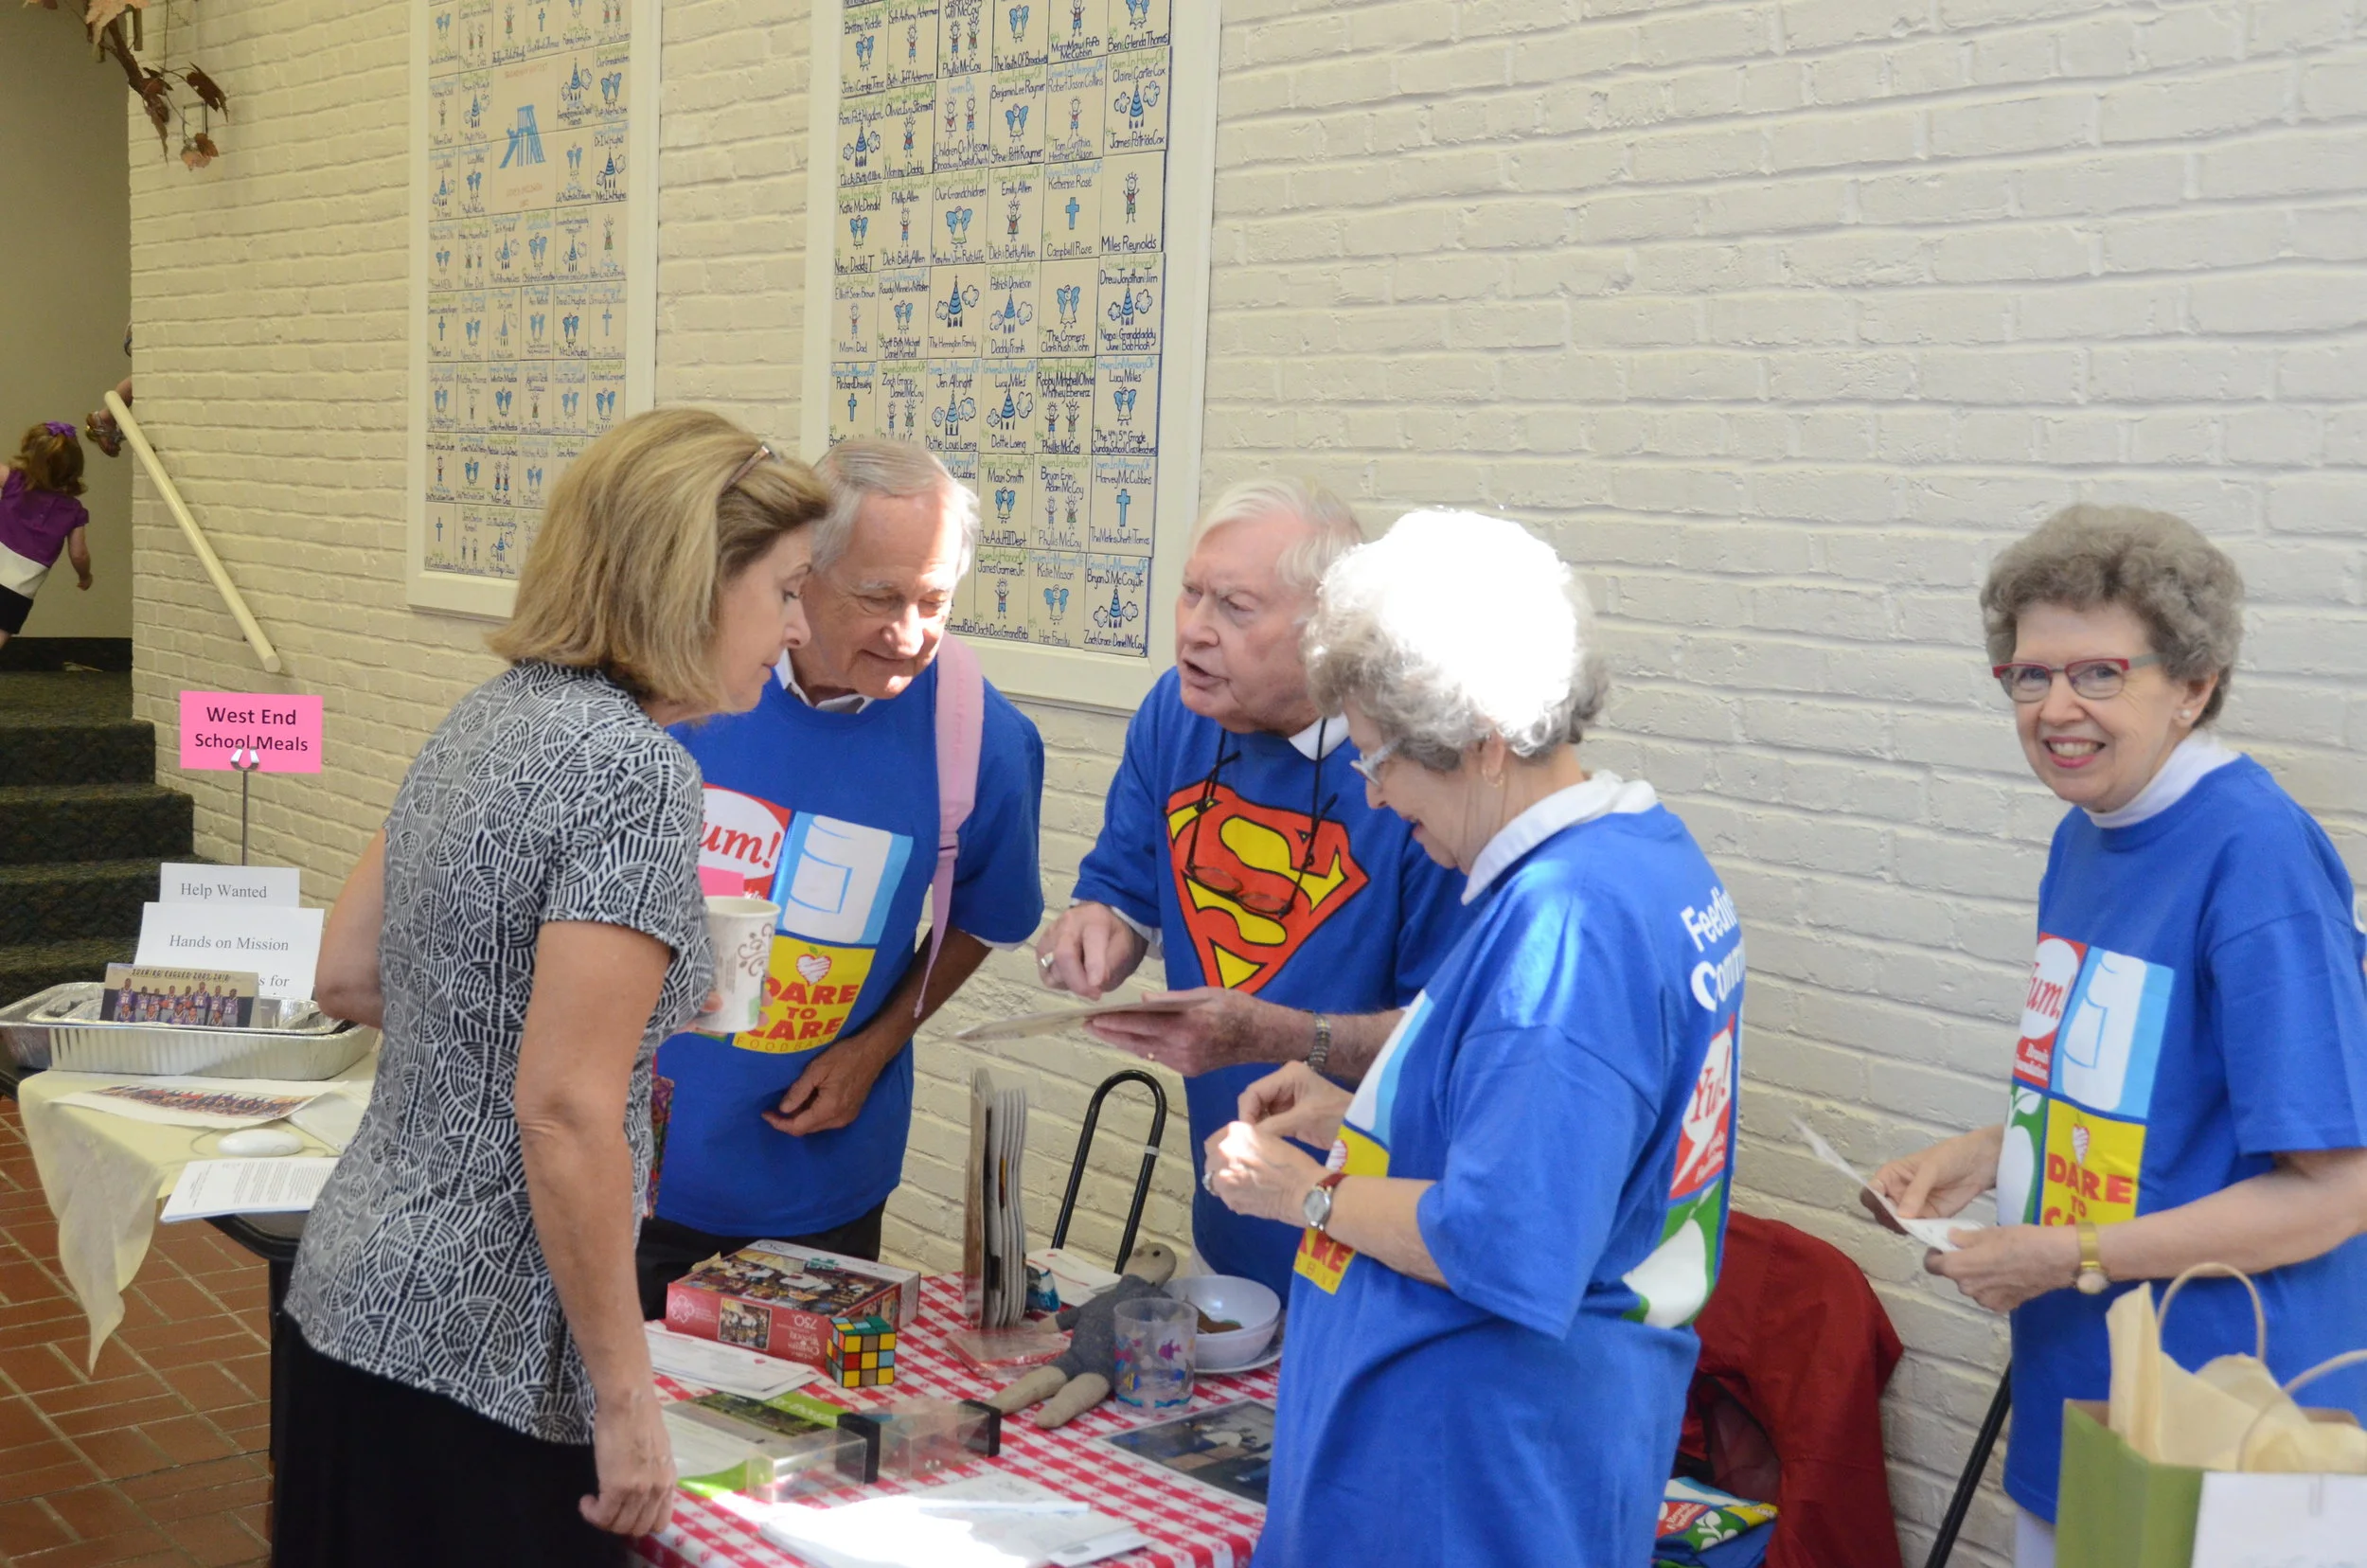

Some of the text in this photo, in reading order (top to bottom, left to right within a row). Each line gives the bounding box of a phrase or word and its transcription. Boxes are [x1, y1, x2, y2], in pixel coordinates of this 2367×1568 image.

[206, 706, 296, 725] West End
[195, 733, 309, 752] School Meals
[698, 816, 781, 869] um!
[181, 882, 267, 899] Help Wanted
[169, 935, 289, 952] Hands on Mission
[270, 974, 290, 987] for
[2026, 961, 2075, 1020] um!
[787, 1007, 817, 1020] TO
[2047, 1151, 2134, 1204] DARE
[2071, 1194, 2088, 1219] TO
